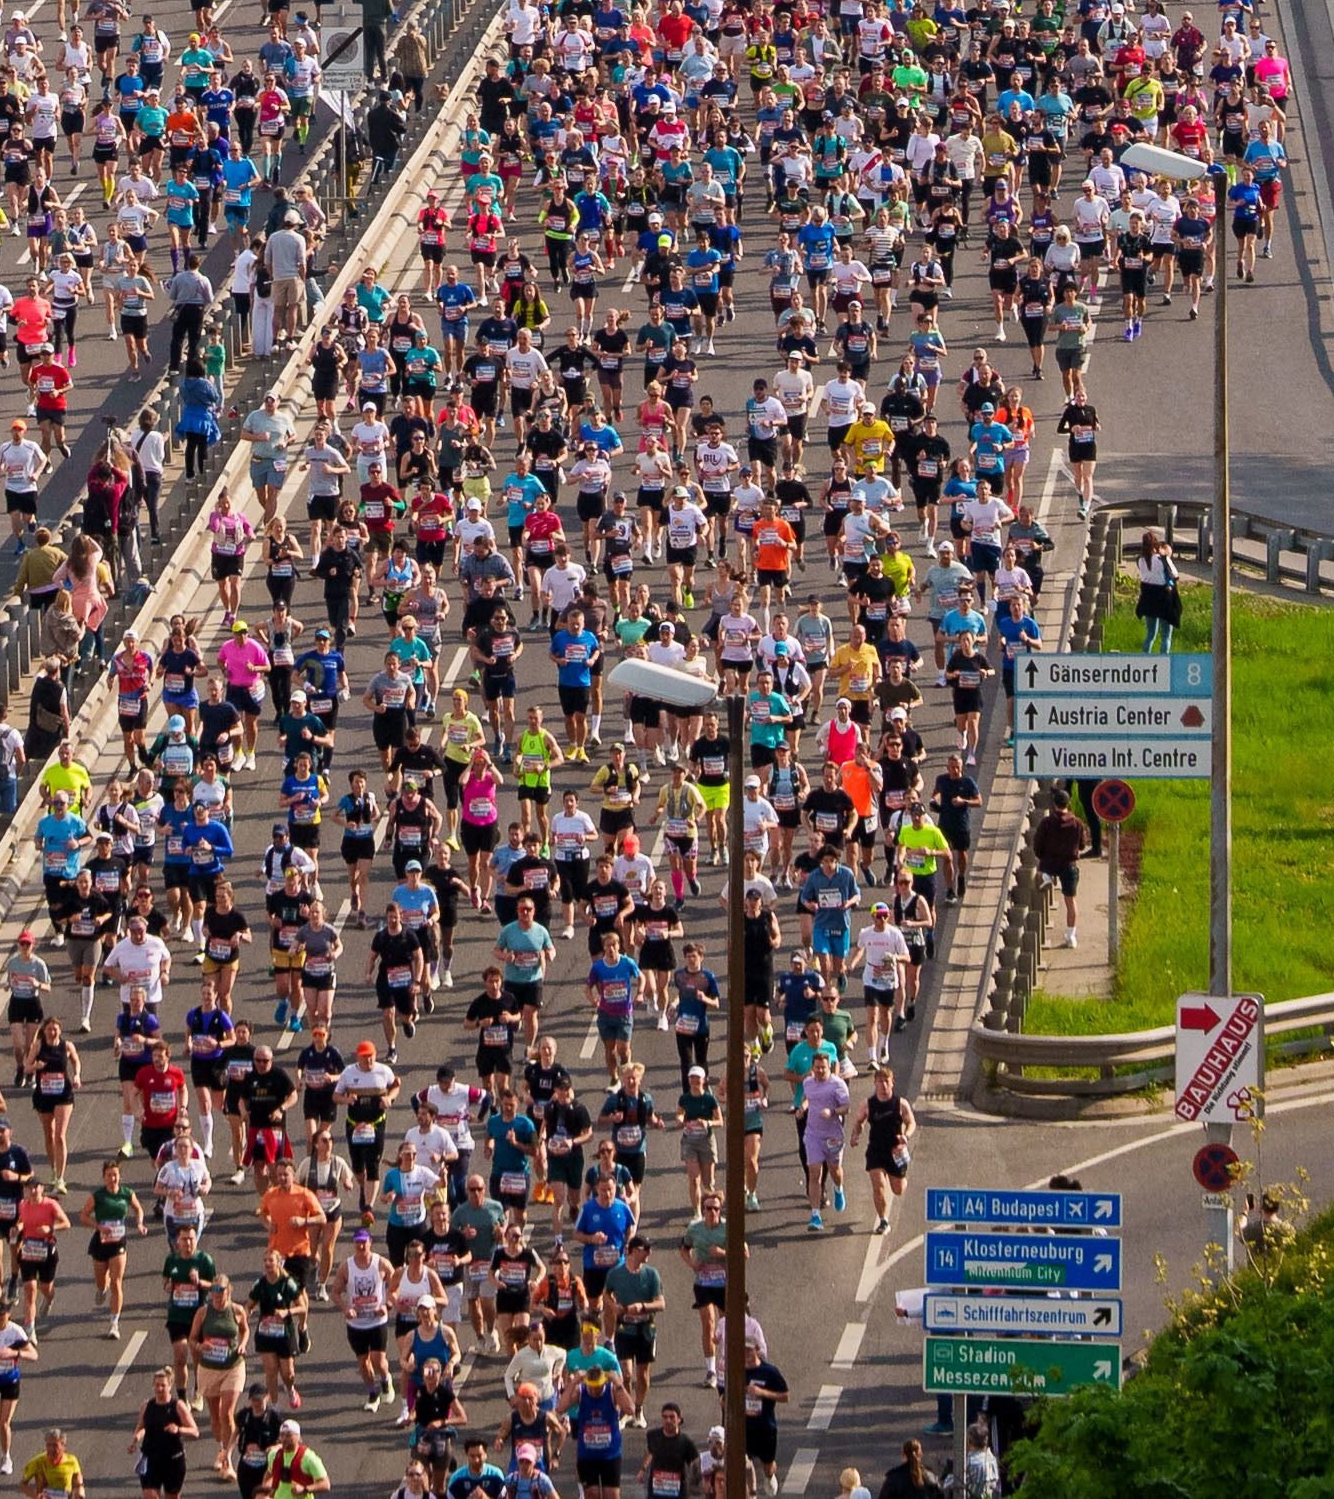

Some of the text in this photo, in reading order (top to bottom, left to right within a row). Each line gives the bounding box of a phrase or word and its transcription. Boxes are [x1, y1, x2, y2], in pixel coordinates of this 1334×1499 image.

[1049, 662, 1202, 686] Gänserndorf 8
[1048, 705, 1171, 725] Austria Center
[1051, 747, 1197, 768] Vienna Int. Centre
[1177, 1000, 1258, 1120] BAUHAUS
[1204, 1042, 1252, 1115] Die Richtung stimmt!
[965, 1197, 1060, 1220] A4 Budapest
[939, 1250, 954, 1267] 14
[964, 1239, 1084, 1264] Klosterneuburg
[1037, 1267, 1061, 1283] City
[963, 1305, 1087, 1325] Schifffahrtszentrum
[959, 1345, 1016, 1364] Stadion
